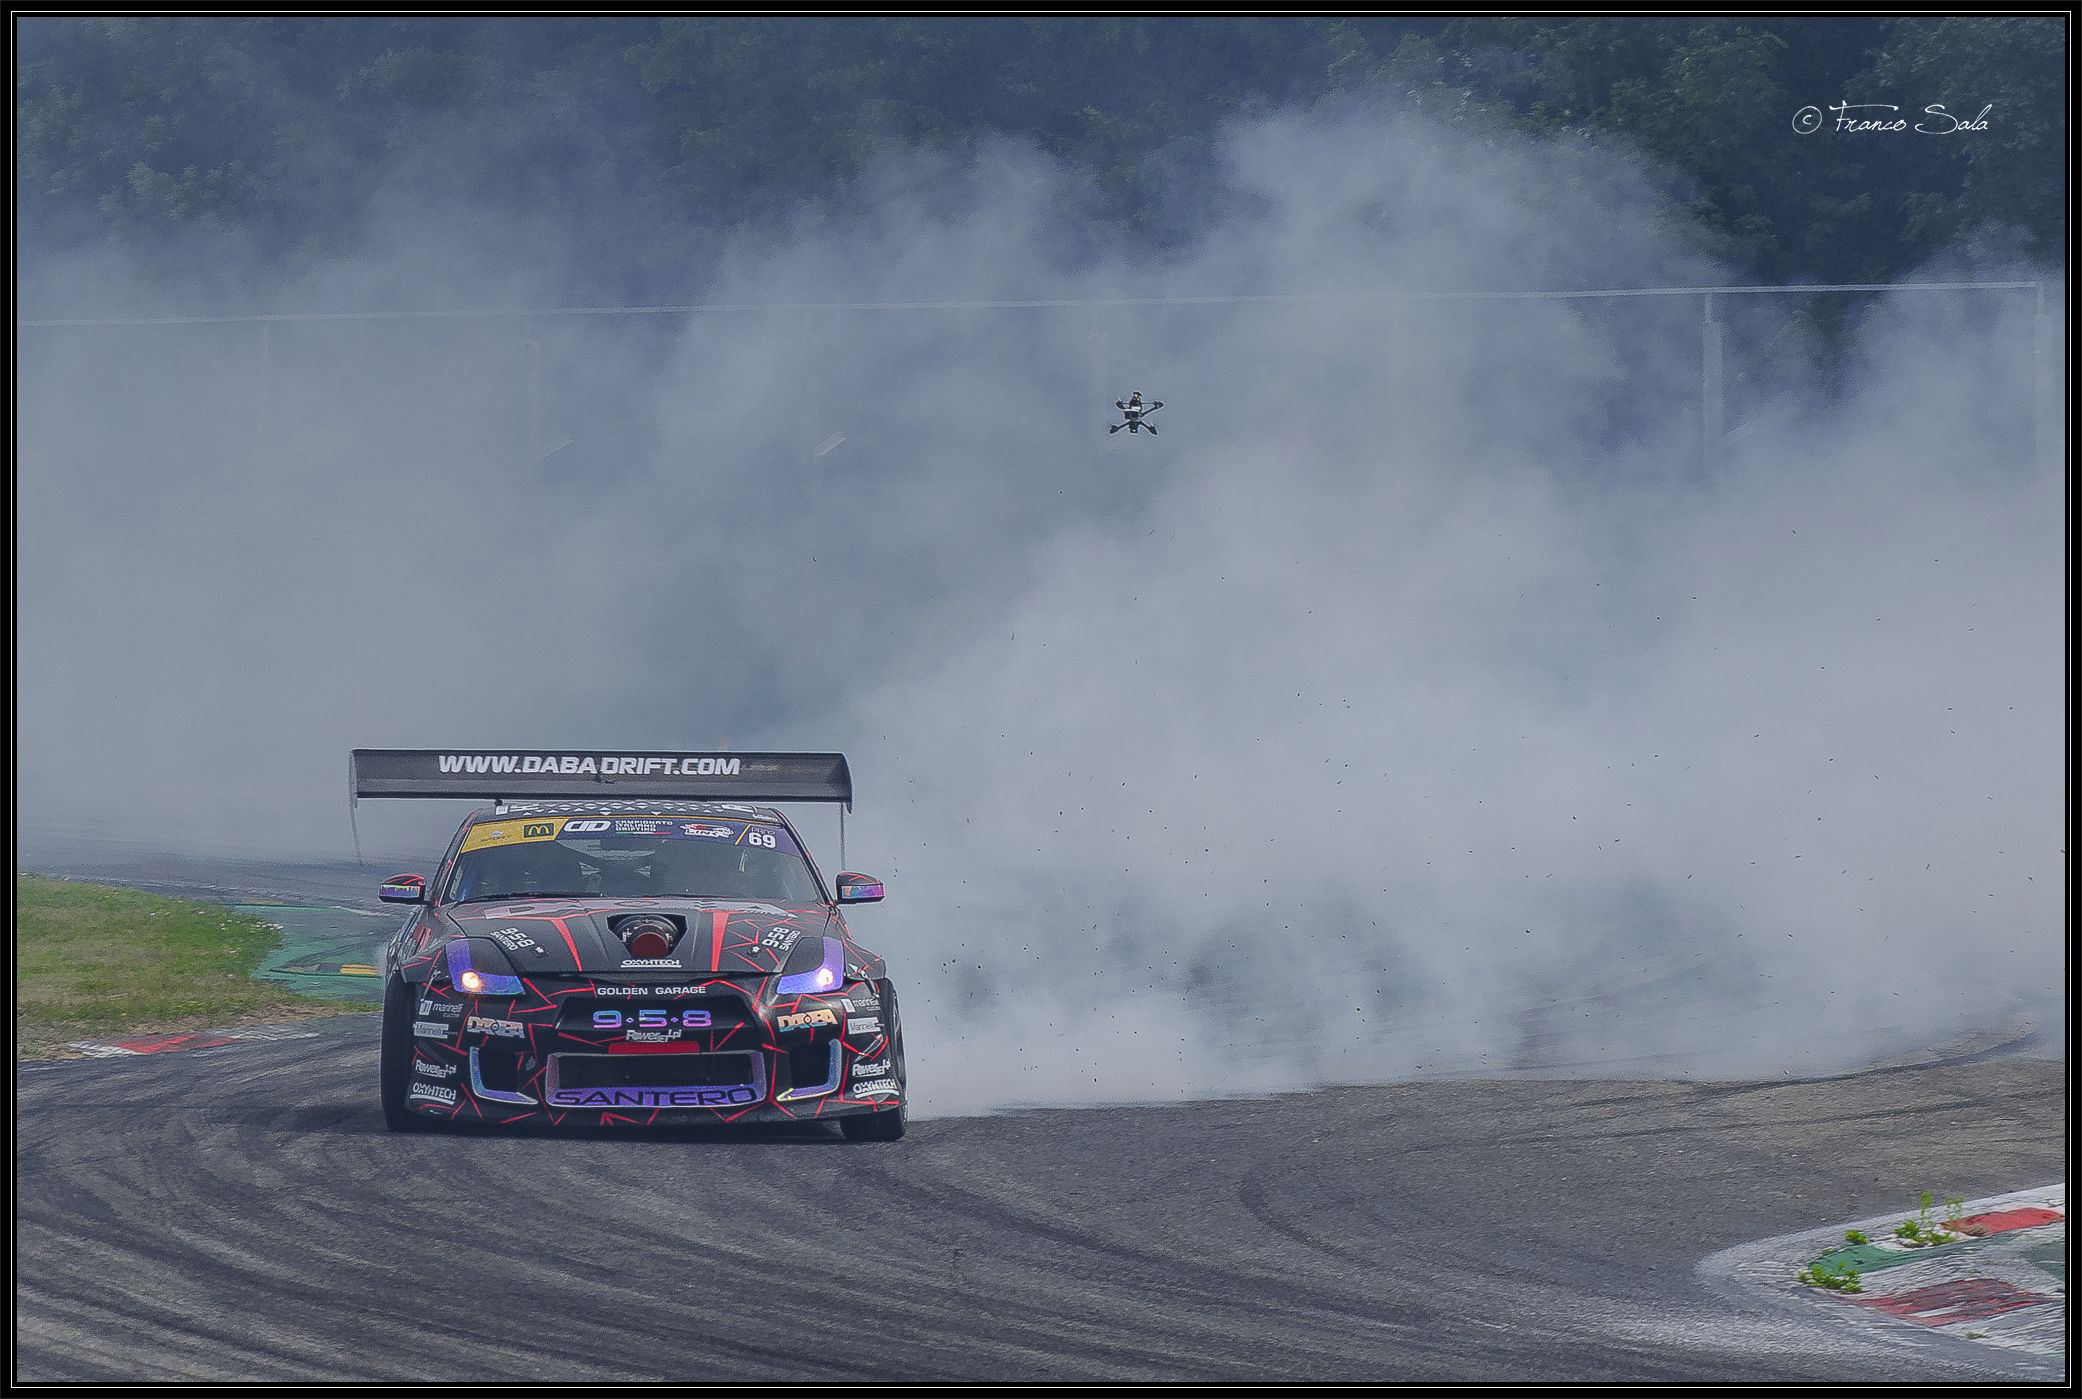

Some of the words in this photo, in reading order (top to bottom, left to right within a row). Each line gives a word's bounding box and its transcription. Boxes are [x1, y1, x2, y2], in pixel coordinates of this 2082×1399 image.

[748, 832, 777, 848] 69
[597, 987, 648, 996] GOLDEN
[655, 986, 707, 995] GARAGE
[553, 1087, 758, 1106] SANTERO
